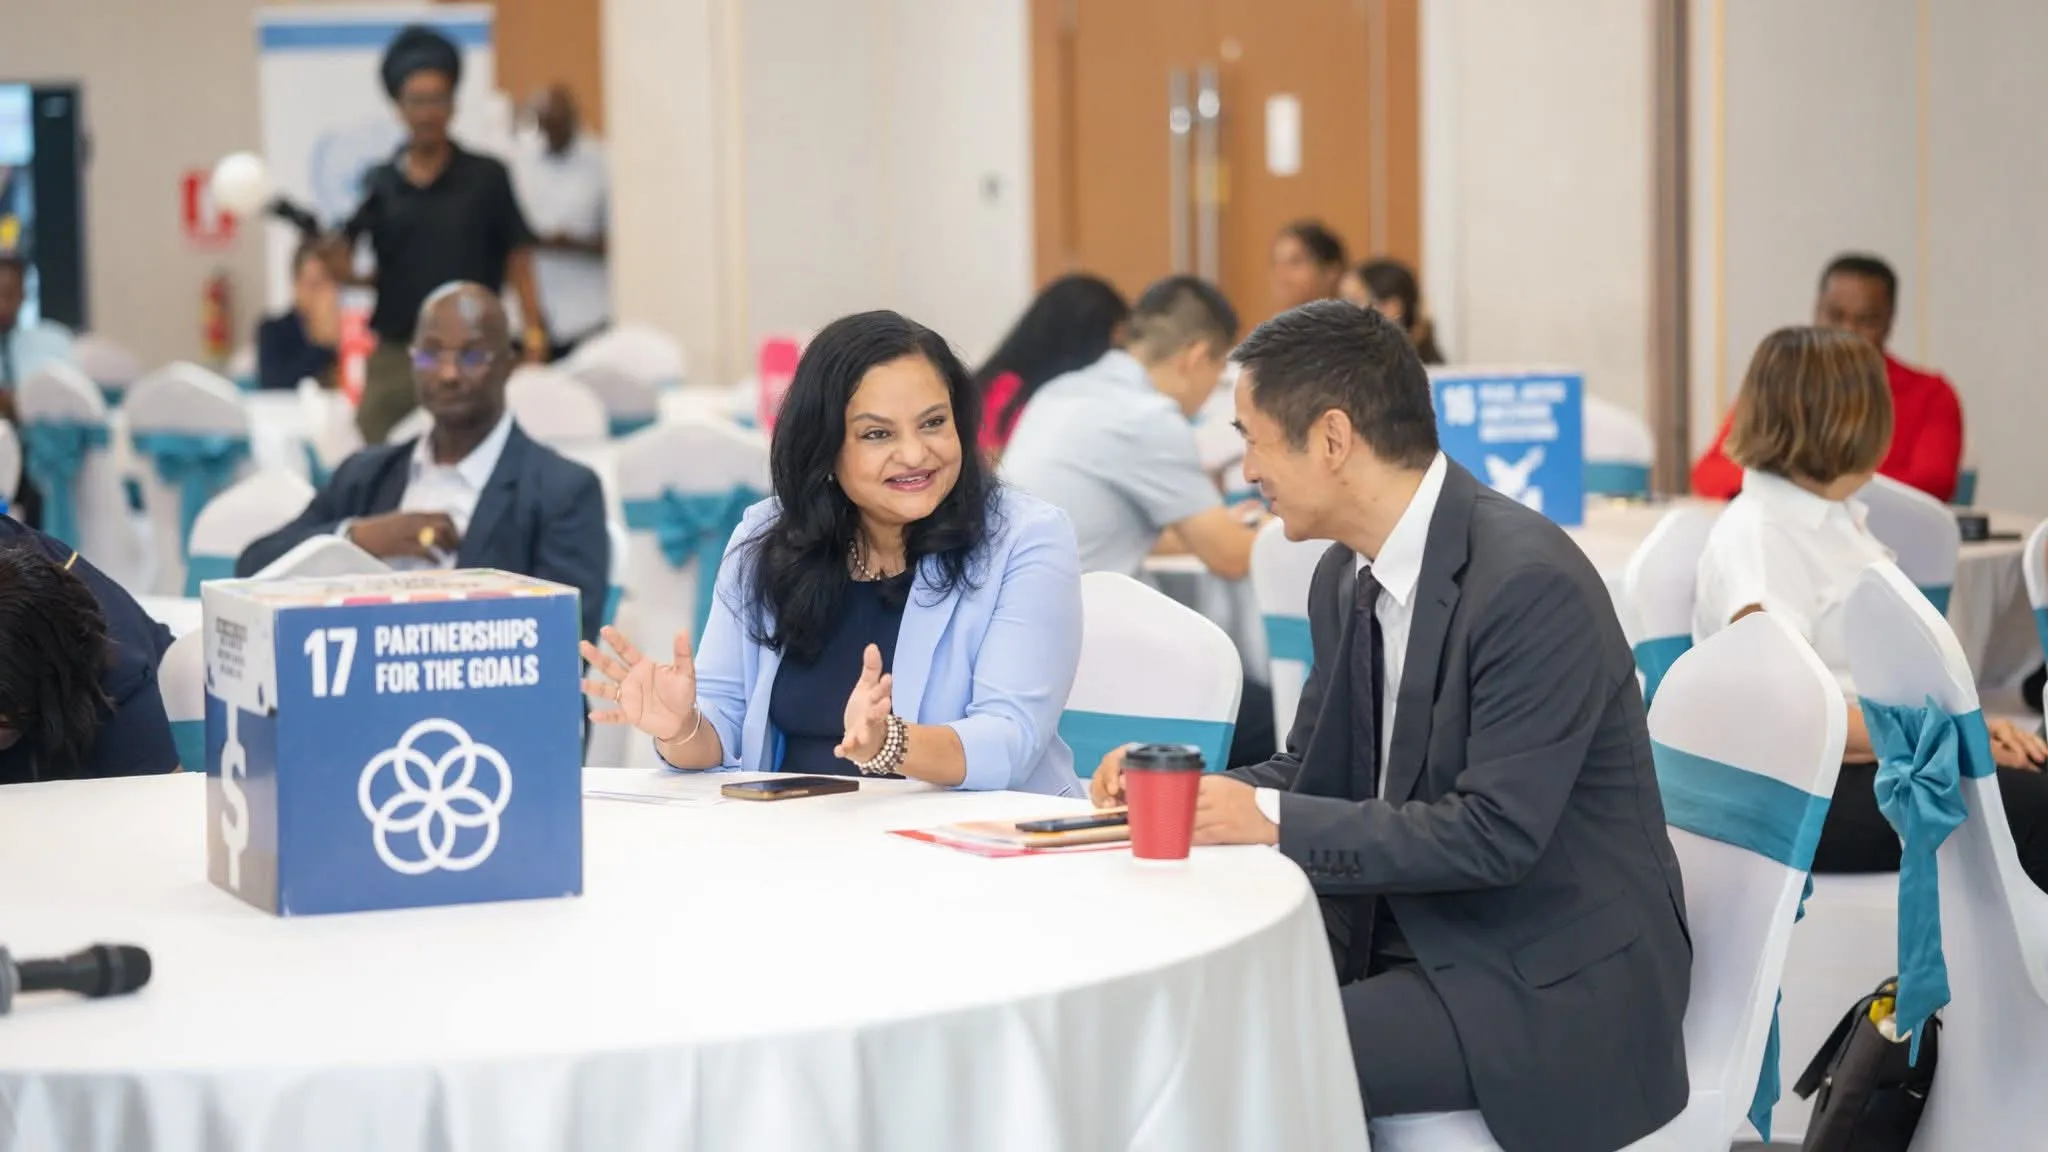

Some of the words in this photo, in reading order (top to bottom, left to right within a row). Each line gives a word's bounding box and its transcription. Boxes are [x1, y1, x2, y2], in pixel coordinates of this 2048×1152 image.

[374, 618, 538, 656] PARTNERSHIPS
[304, 627, 358, 697] 17
[375, 661, 420, 694] FOR
[422, 658, 466, 692] THE
[467, 654, 540, 689] GOALS
